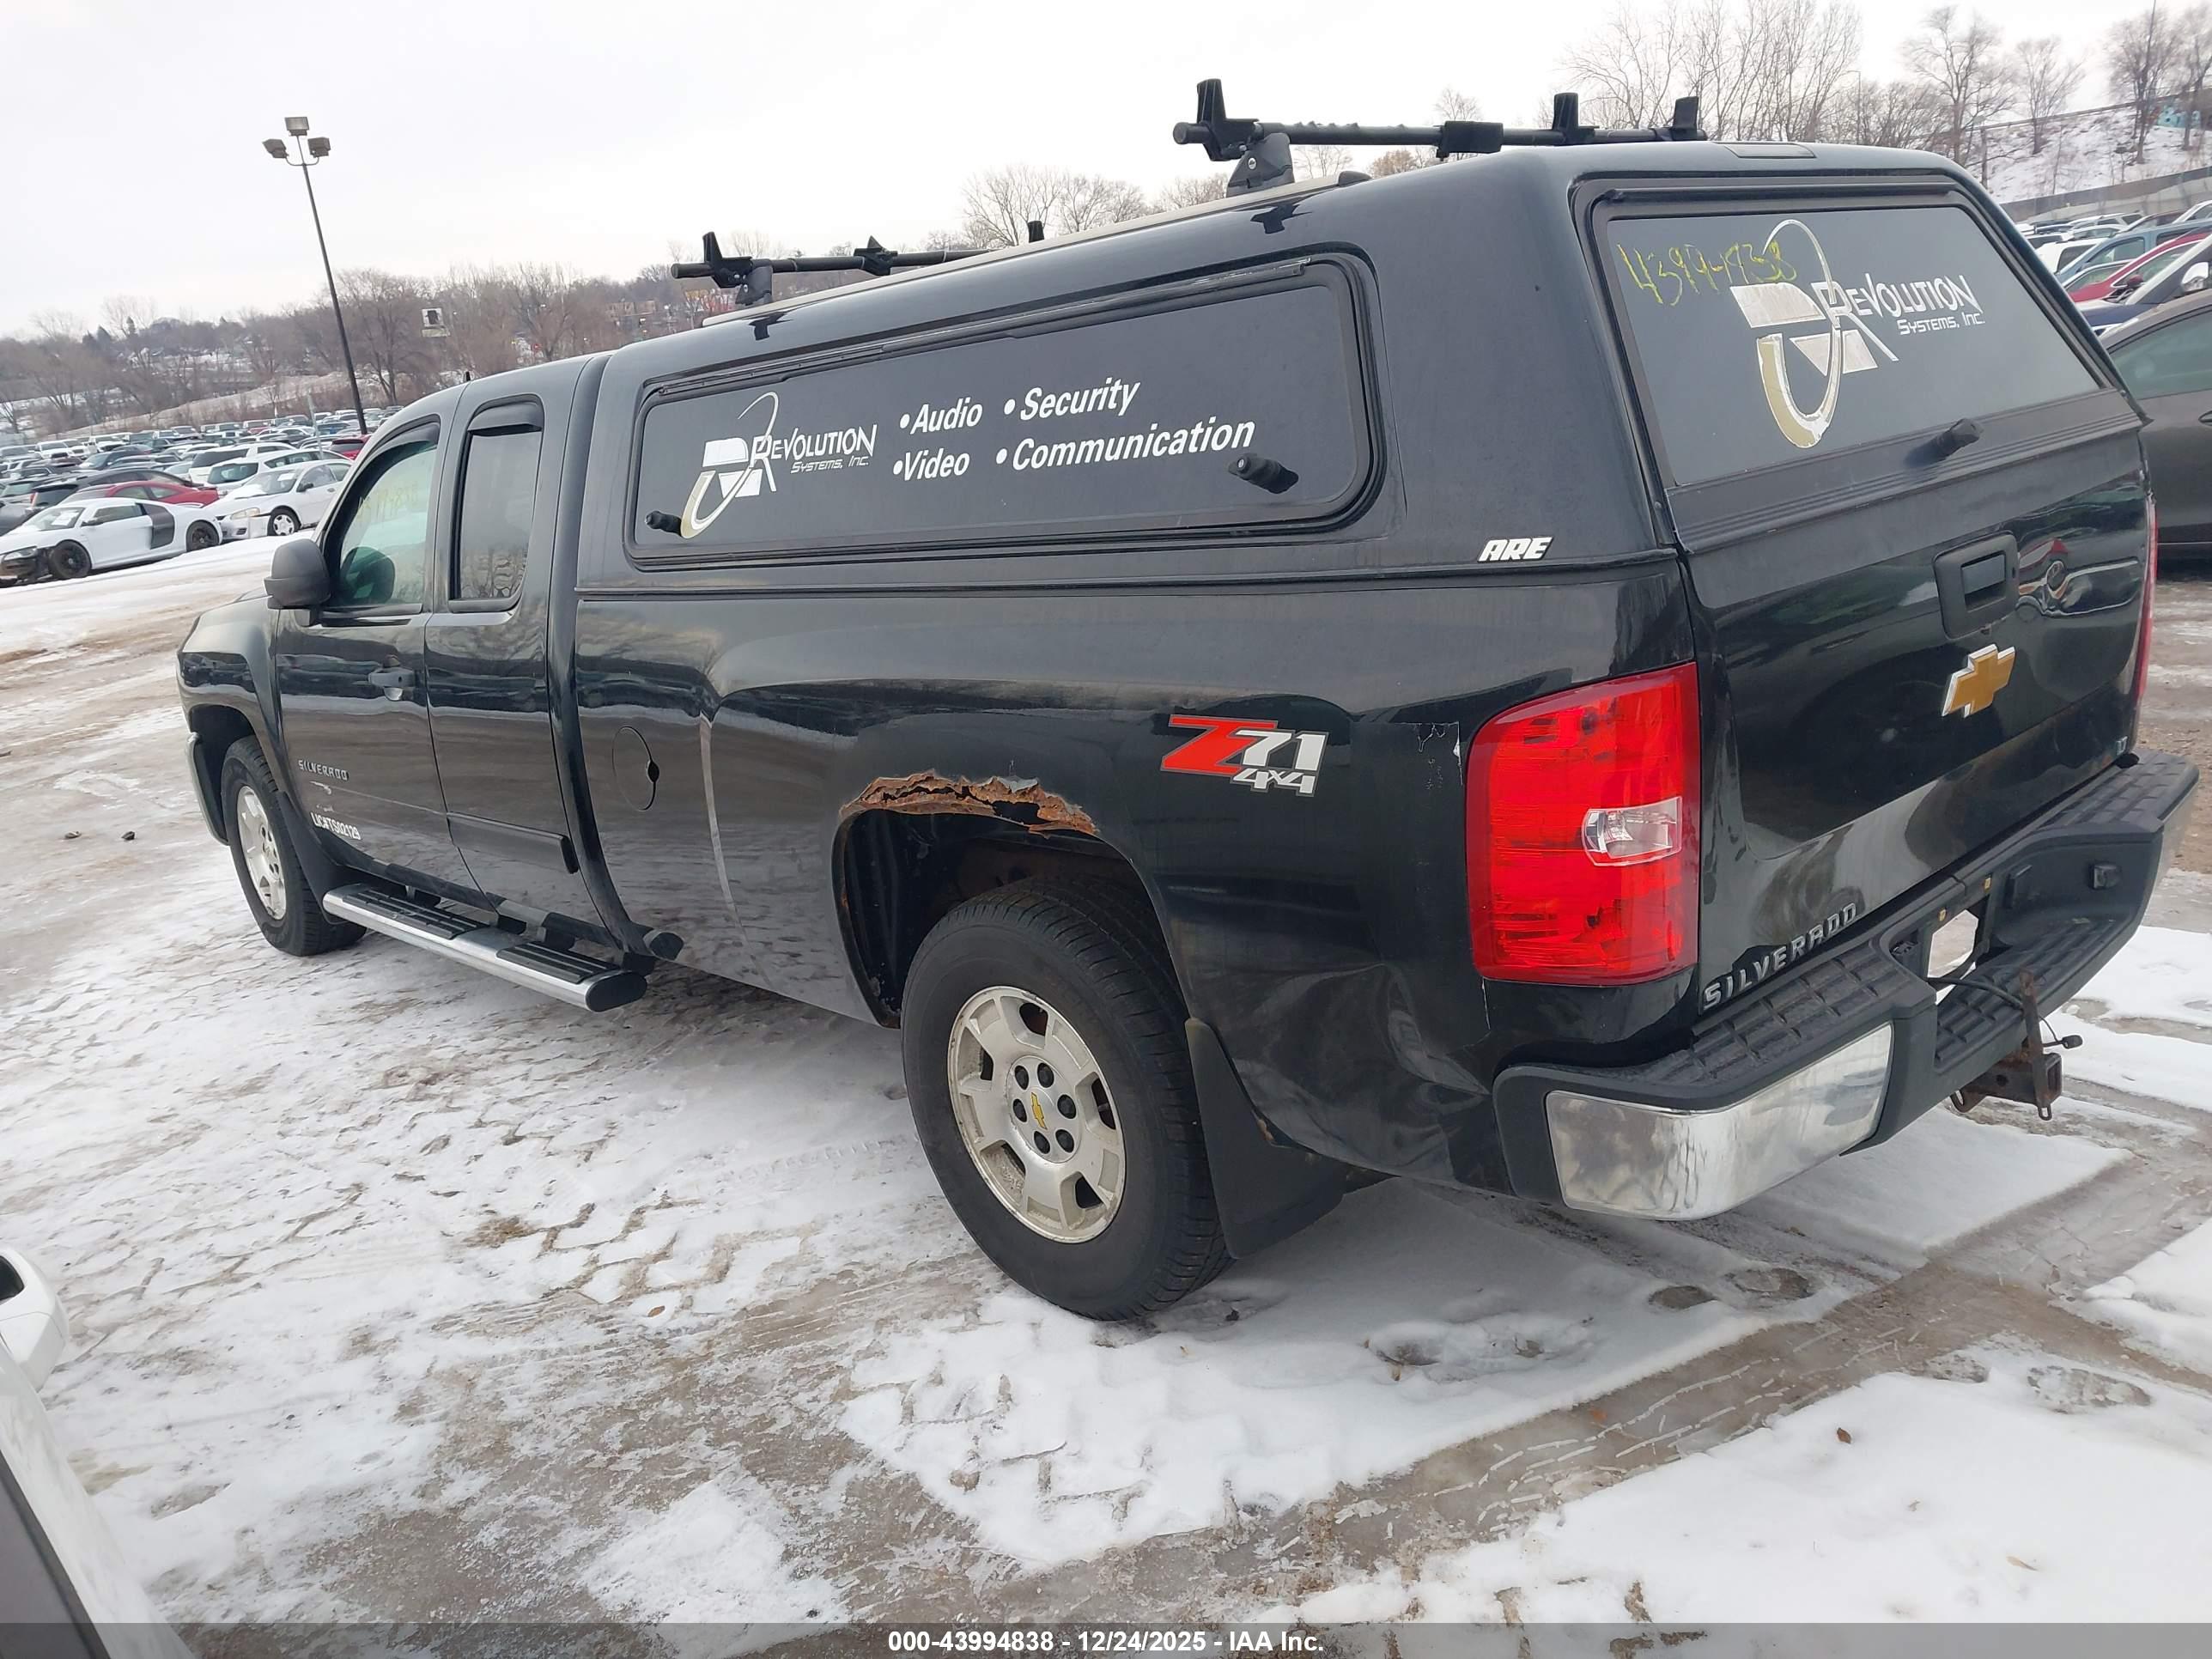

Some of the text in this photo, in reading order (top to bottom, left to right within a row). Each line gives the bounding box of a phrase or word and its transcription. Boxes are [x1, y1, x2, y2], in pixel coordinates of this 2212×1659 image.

[1019, 377, 1140, 421] Security
[1012, 416, 1255, 471] Communication
[1478, 537, 1554, 562] ARE
[298, 759, 349, 781] SILVERADO
[1161, 714, 1329, 777] Z71
[1703, 902, 1856, 1012] SILVERADO
